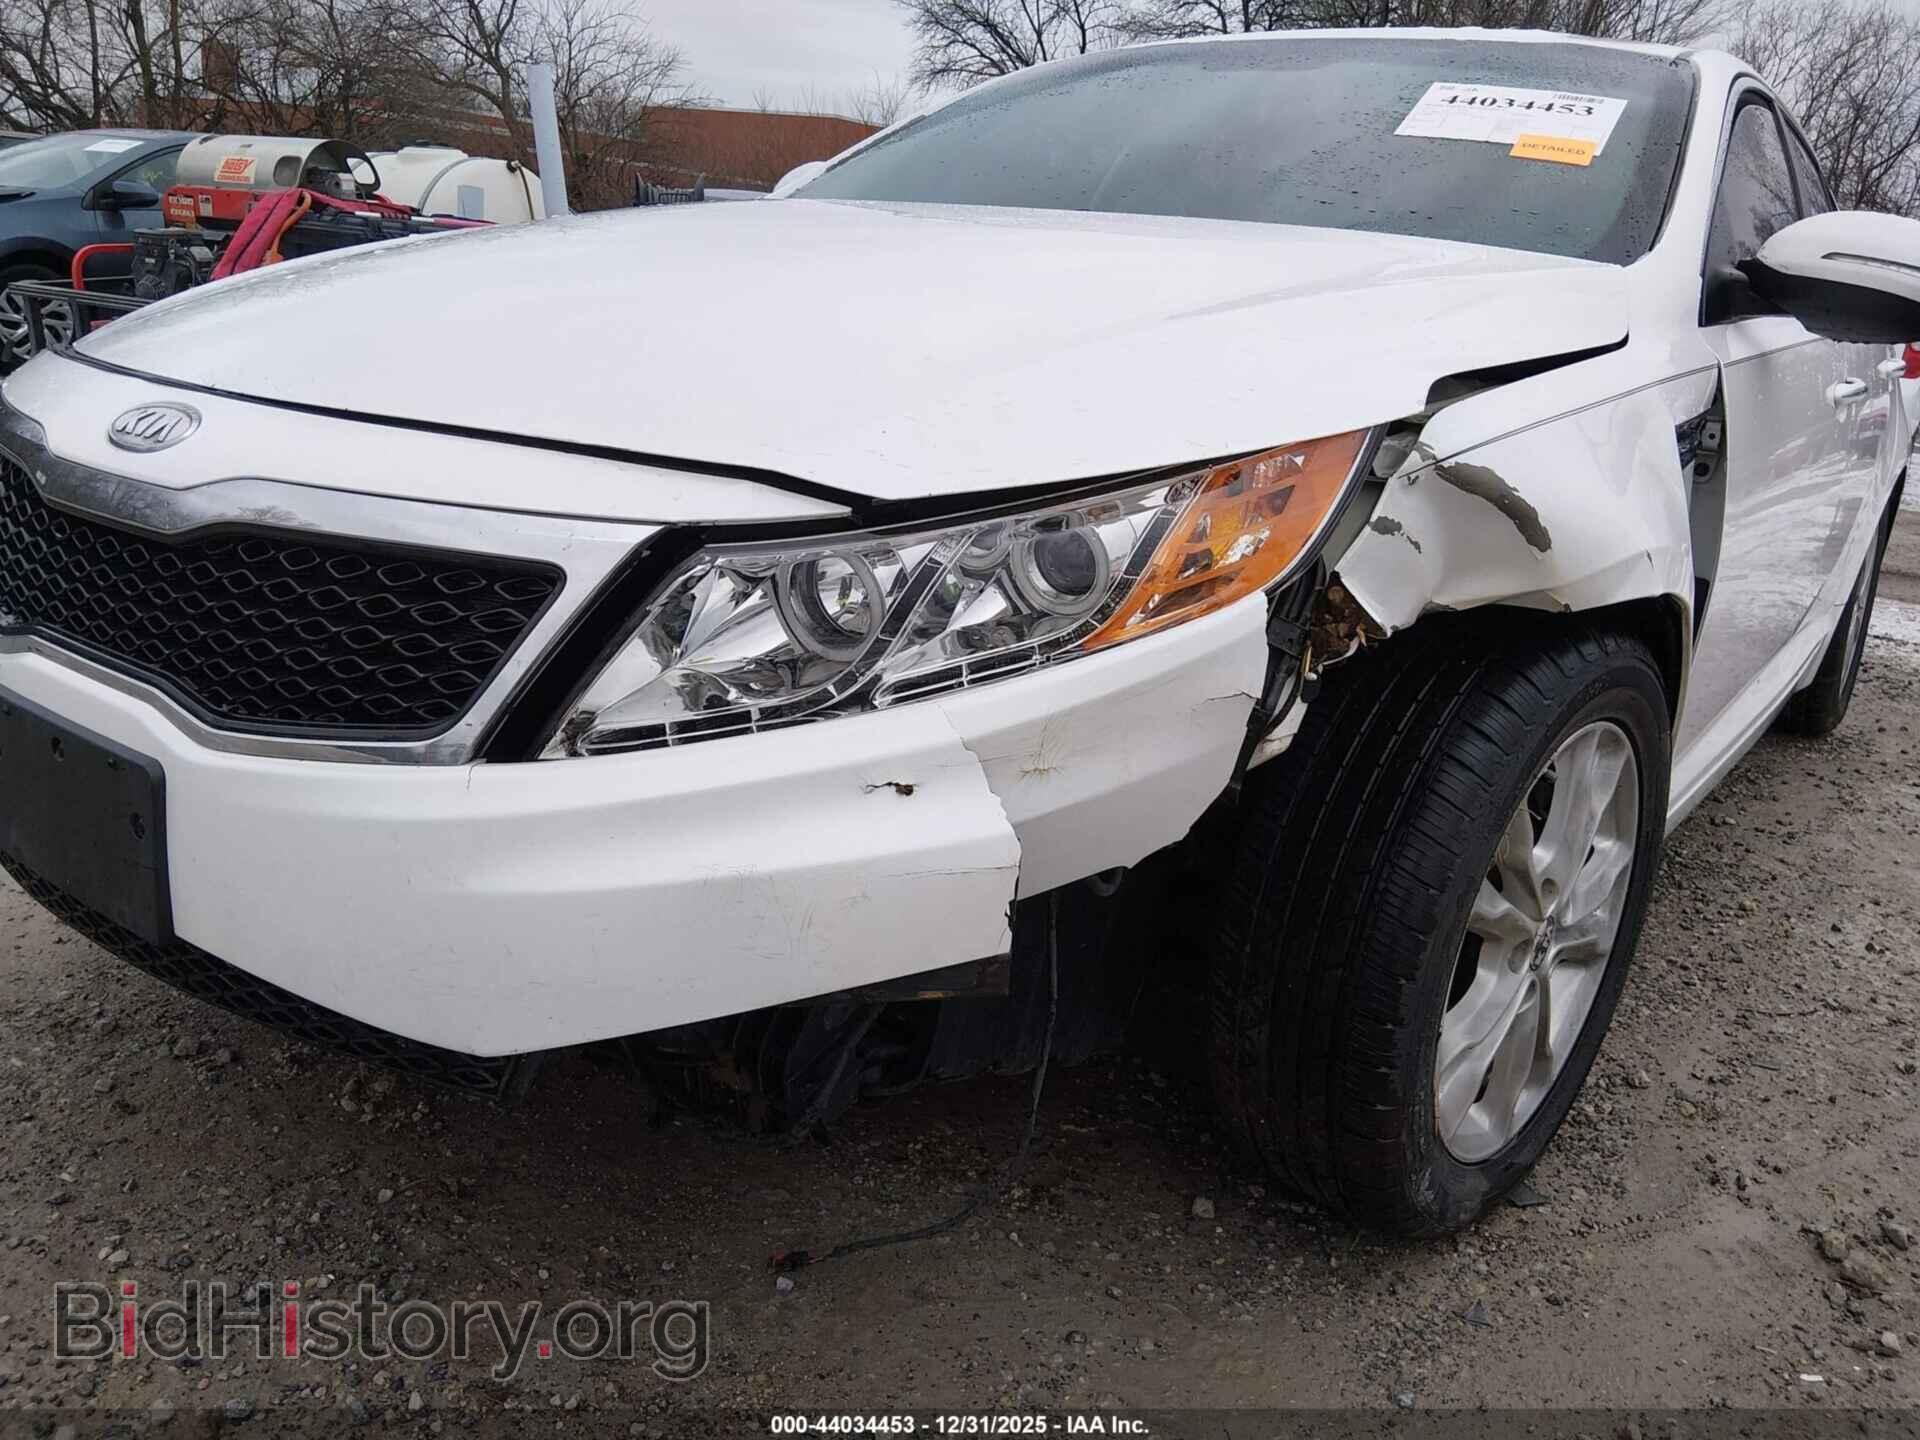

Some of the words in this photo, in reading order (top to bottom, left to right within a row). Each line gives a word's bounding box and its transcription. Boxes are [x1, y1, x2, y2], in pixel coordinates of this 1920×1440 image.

[1440, 94, 1596, 118] 44034453
[1521, 142, 1587, 156] DETAILED
[114, 407, 184, 444] KIA
